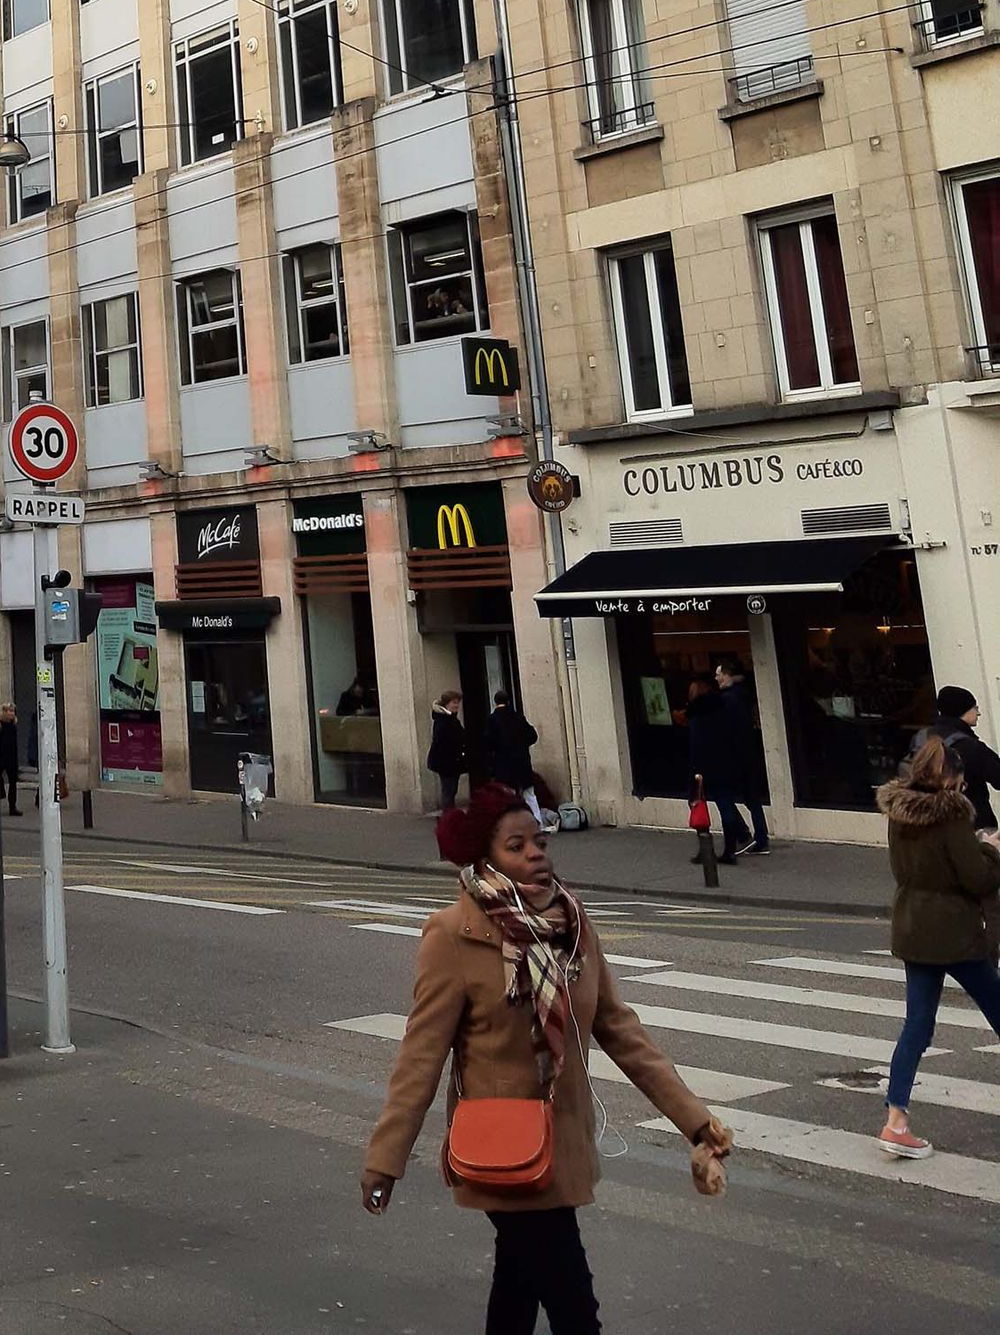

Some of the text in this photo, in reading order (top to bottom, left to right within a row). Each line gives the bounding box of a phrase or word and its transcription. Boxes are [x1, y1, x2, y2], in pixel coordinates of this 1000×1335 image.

[26, 427, 64, 458] 30
[532, 463, 571, 483] COLUMBUS
[624, 455, 863, 496] COLUMBUS CAFÉ&CO
[13, 500, 80, 519] RAPPEL
[292, 513, 364, 532] McDonald's
[198, 514, 241, 554] McCafé
[984, 544, 998, 555] 57
[595, 598, 712, 615] Vente à emporter
[192, 615, 233, 628] Mc Donald's
